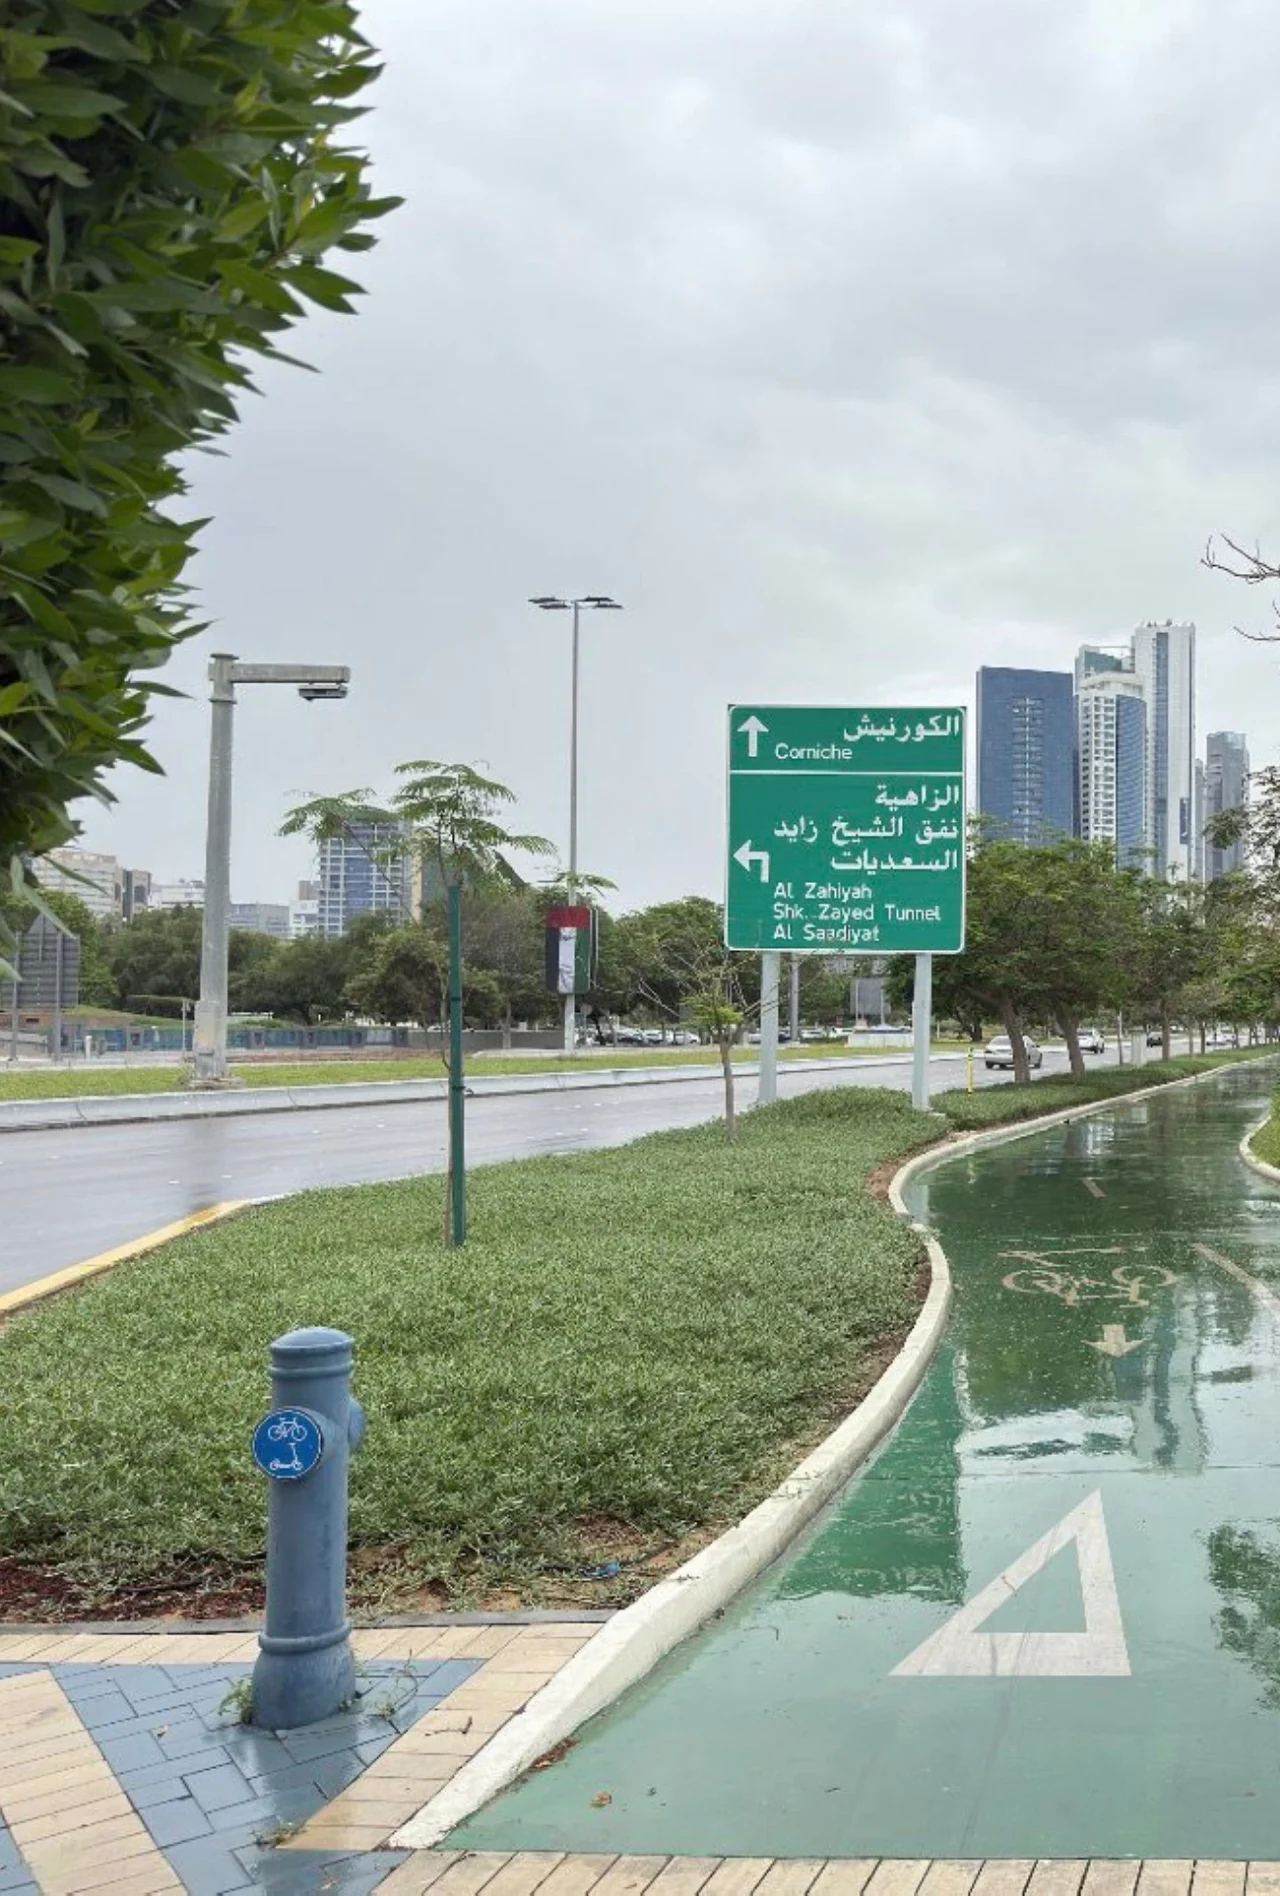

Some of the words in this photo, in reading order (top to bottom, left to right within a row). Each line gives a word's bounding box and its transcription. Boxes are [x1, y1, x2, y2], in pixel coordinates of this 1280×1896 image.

[843, 714, 959, 742] الكورنيش
[775, 743, 853, 760] Corniche
[875, 784, 959, 811] الزاهية
[773, 815, 818, 843] زايد
[831, 815, 903, 846] الشيخ
[915, 817, 959, 845] نفق
[831, 848, 958, 875] السعديات
[773, 882, 794, 899] Al
[804, 882, 872, 902] Zahiyah
[773, 903, 808, 920] Shk.
[818, 903, 875, 923] Zayed
[885, 904, 941, 921] Tunnel
[773, 924, 792, 940] Al
[803, 923, 880, 944] Saadiyat
